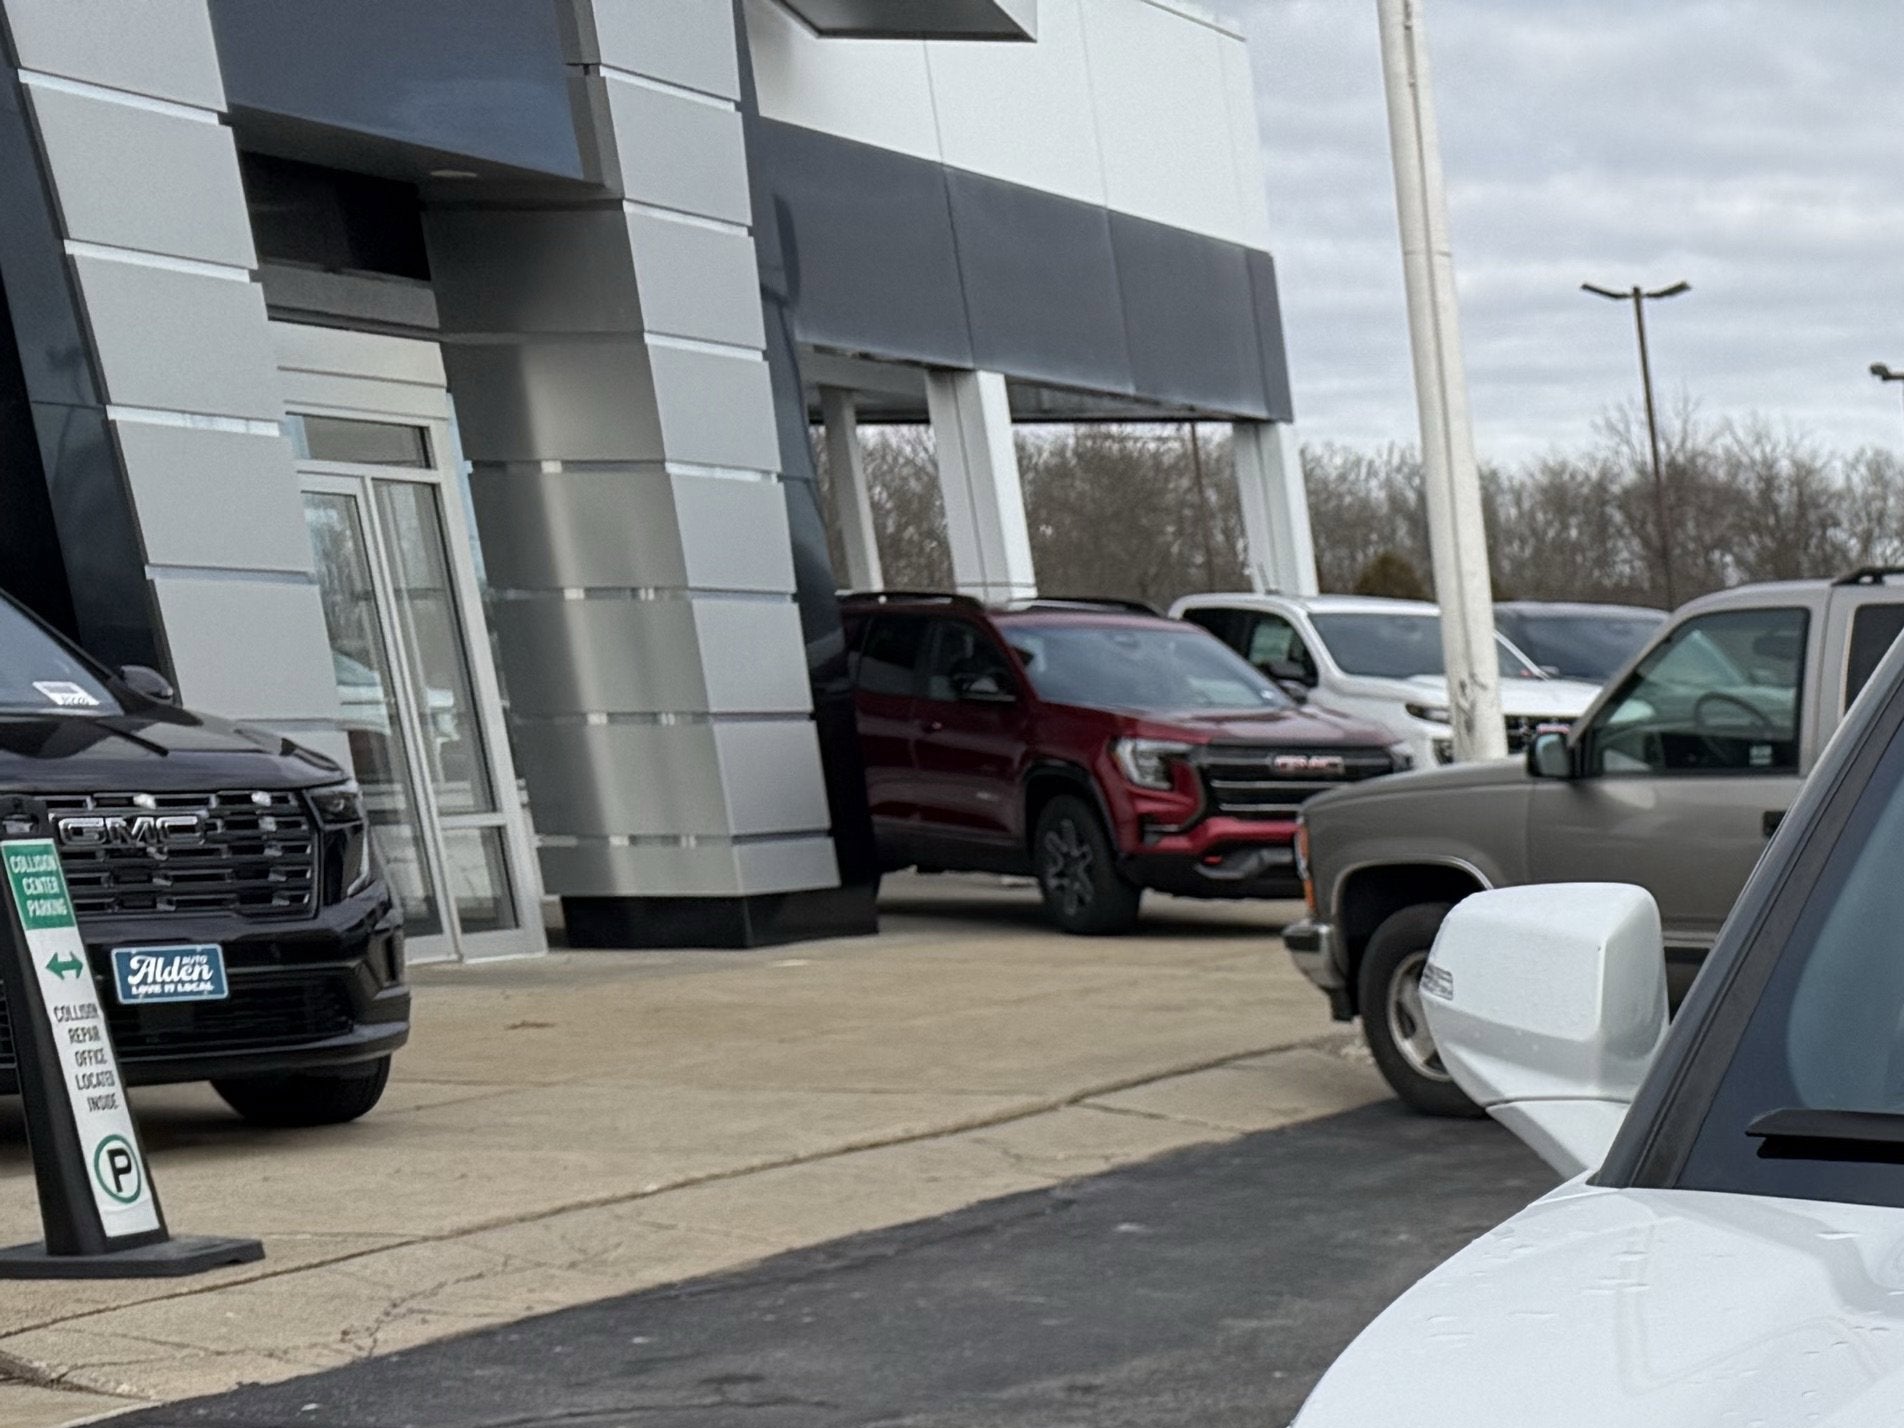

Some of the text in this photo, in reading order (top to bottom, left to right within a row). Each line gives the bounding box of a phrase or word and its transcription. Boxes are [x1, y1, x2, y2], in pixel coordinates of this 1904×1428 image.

[58, 815, 204, 845] GMC
[9, 854, 57, 874] COLLISION
[22, 875, 60, 896] CENTER
[26, 897, 68, 917] PARKING
[127, 955, 214, 985] Alden
[54, 1002, 99, 1023] COLLISION
[68, 1025, 100, 1044] REPAIR
[74, 1047, 107, 1067] OFFICE
[75, 1070, 115, 1090] LOCATED
[87, 1093, 119, 1112] INSIDE
[107, 1147, 132, 1193] P
